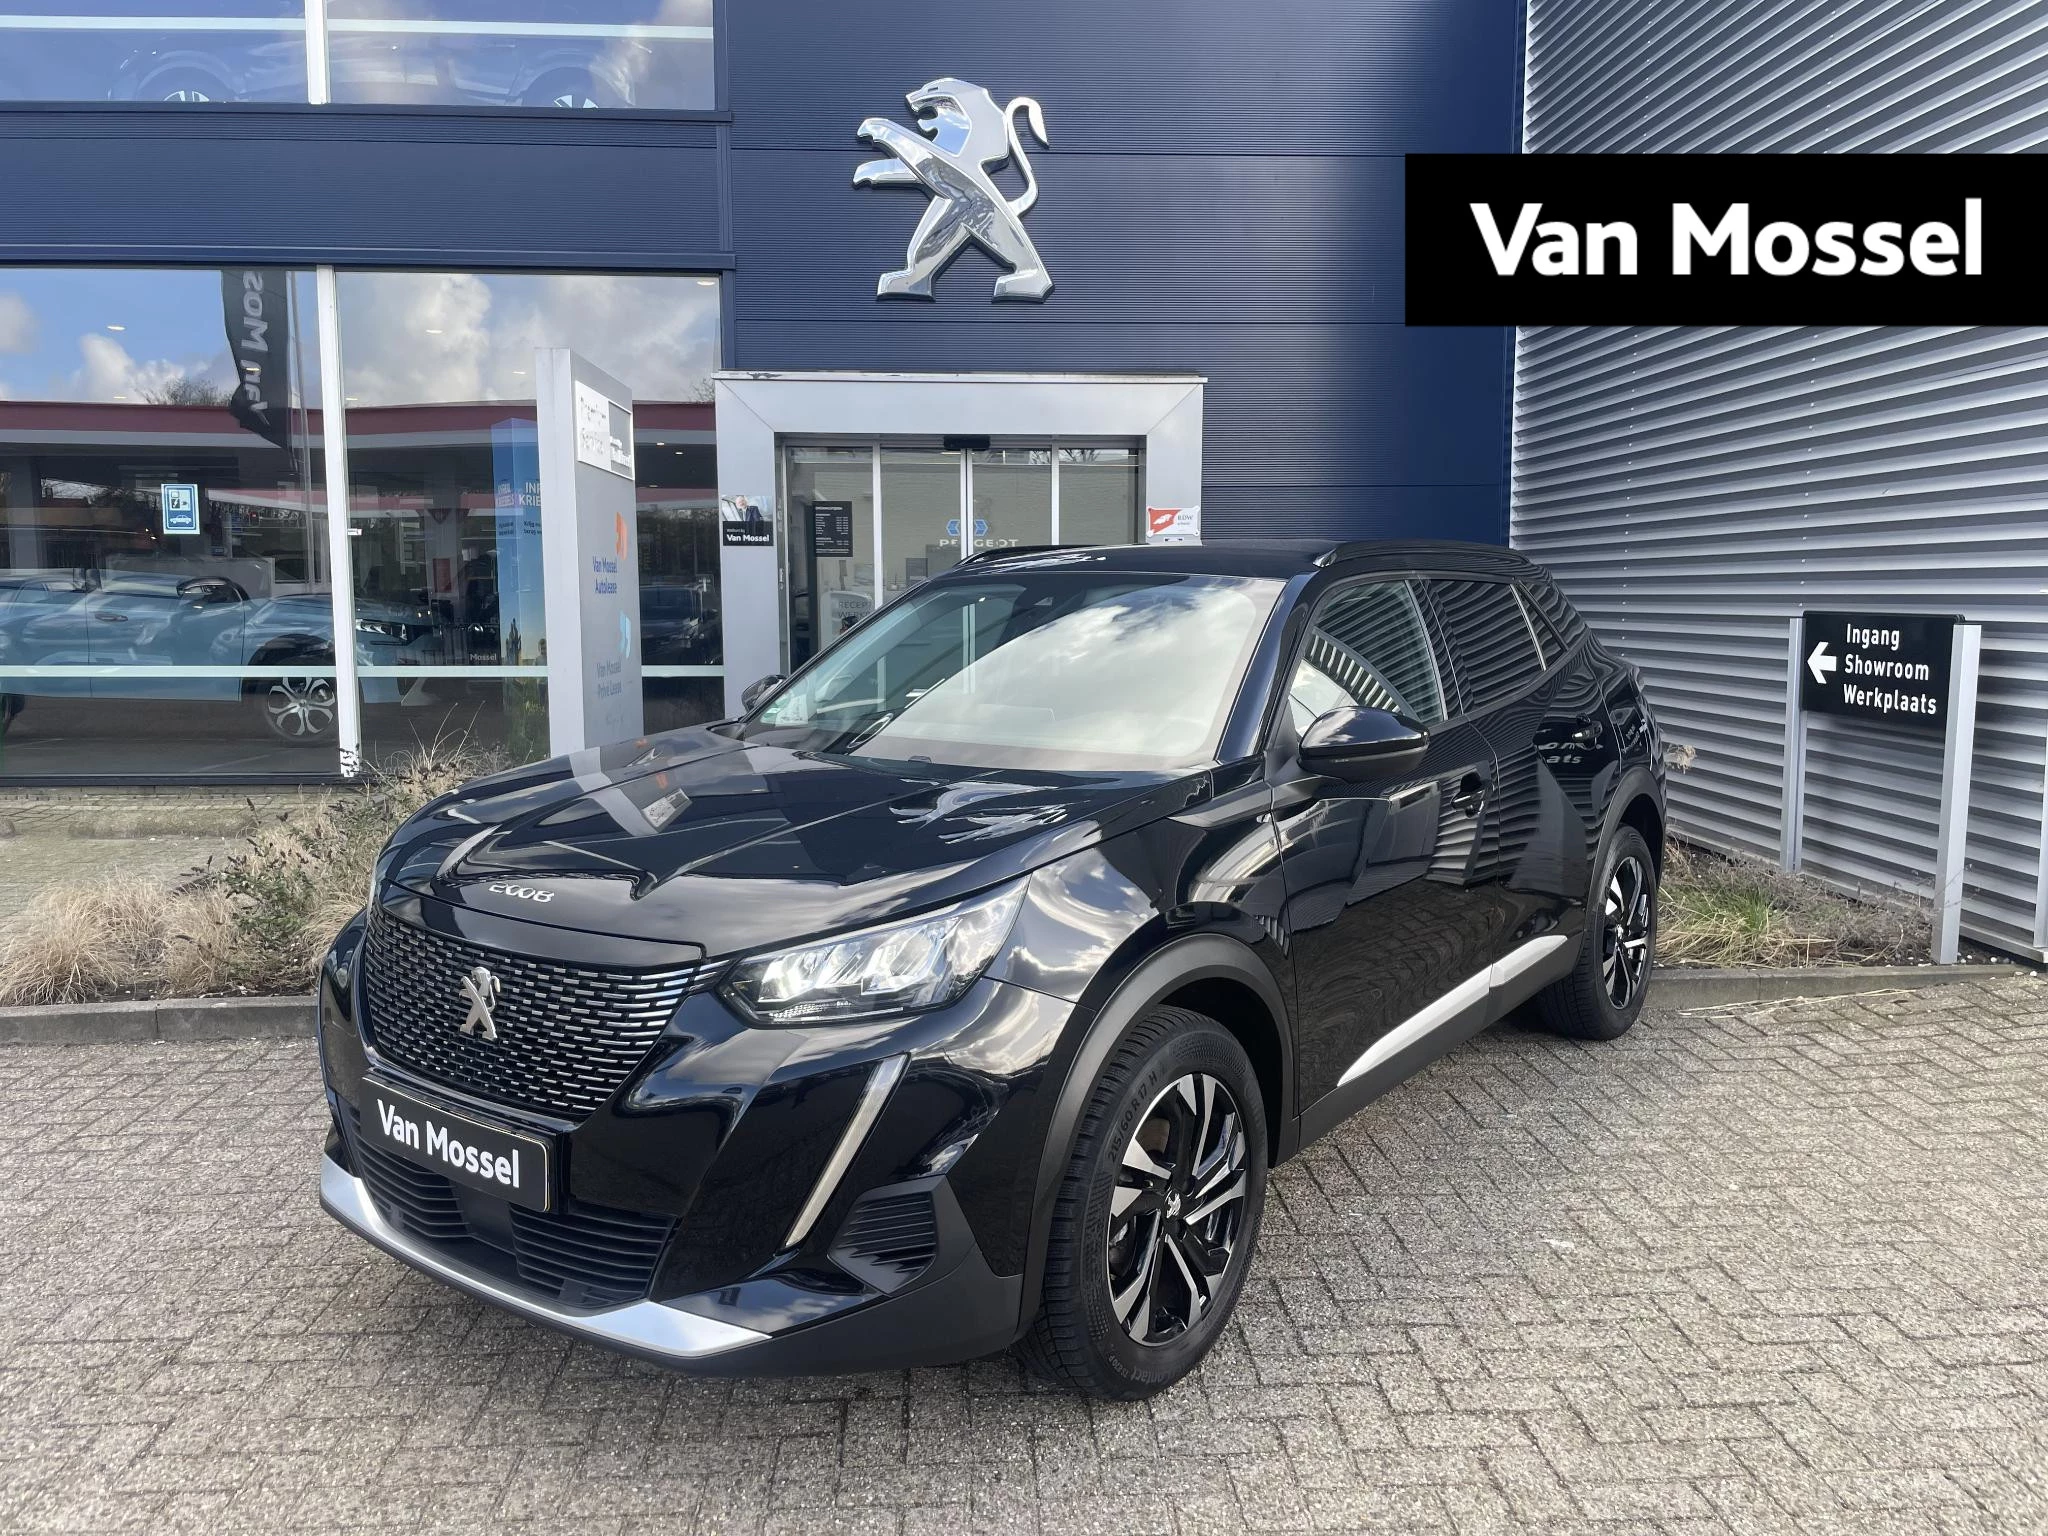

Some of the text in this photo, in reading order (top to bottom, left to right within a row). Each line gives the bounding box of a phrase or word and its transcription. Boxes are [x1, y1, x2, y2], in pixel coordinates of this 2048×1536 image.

[727, 534, 769, 542] Van Mossel
[939, 539, 1018, 548] PEGEOT
[1846, 623, 1900, 651] Ingang
[470, 653, 497, 661] Mossel
[1844, 653, 1929, 681] Showroom
[1843, 683, 1937, 715] Werkplaats
[488, 881, 555, 903] 2008
[377, 1099, 520, 1188] Van Mossel
[1107, 1110, 1135, 1162] 215/60
